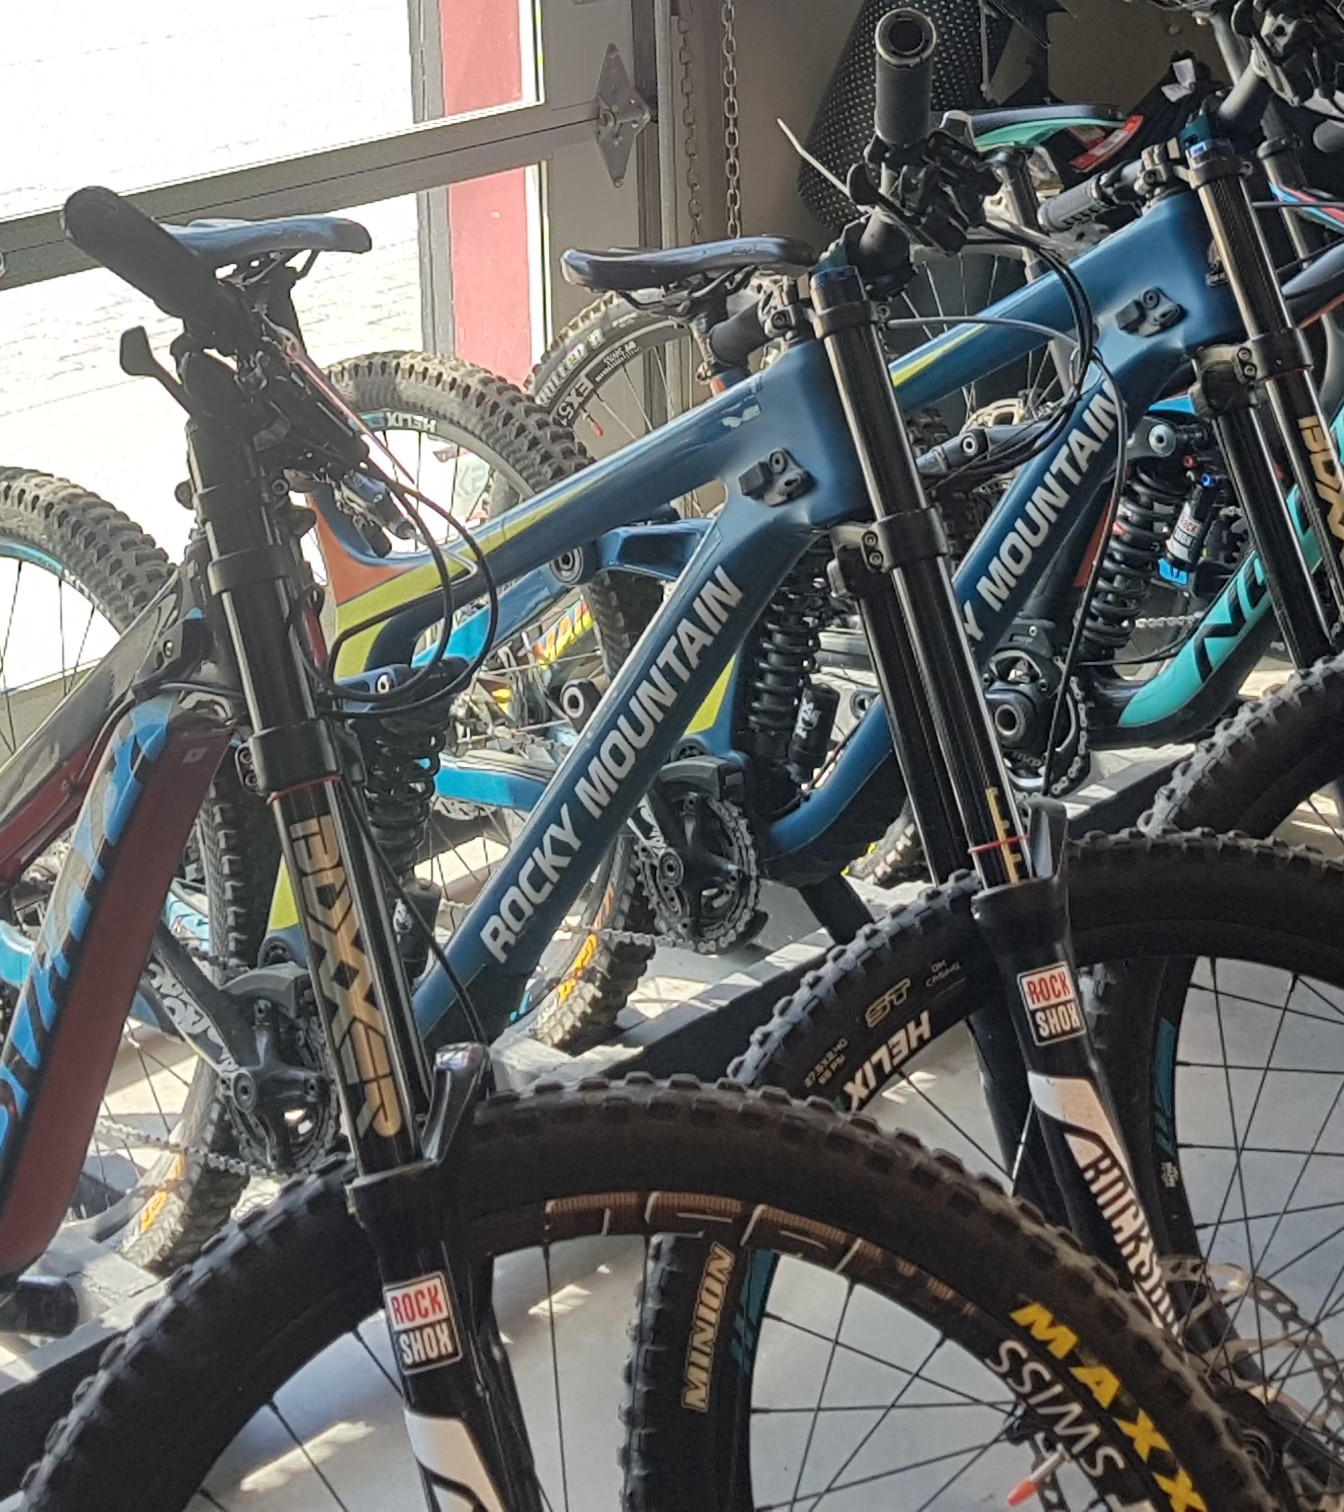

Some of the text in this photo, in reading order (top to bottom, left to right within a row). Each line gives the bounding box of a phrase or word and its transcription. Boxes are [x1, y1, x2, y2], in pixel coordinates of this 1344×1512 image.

[975, 385, 1119, 614] MOUNTAIN
[479, 566, 744, 965] ROCKY MOUNTAIN
[1027, 970, 1071, 1007] ROCK
[1035, 1003, 1081, 1038] SHOX
[843, 1009, 932, 1113] HELIX
[390, 1284, 443, 1325] ROCK
[399, 1325, 455, 1366] SHOX
[681, 1240, 737, 1414] MINION
[984, 1339, 1127, 1478] SWISS
